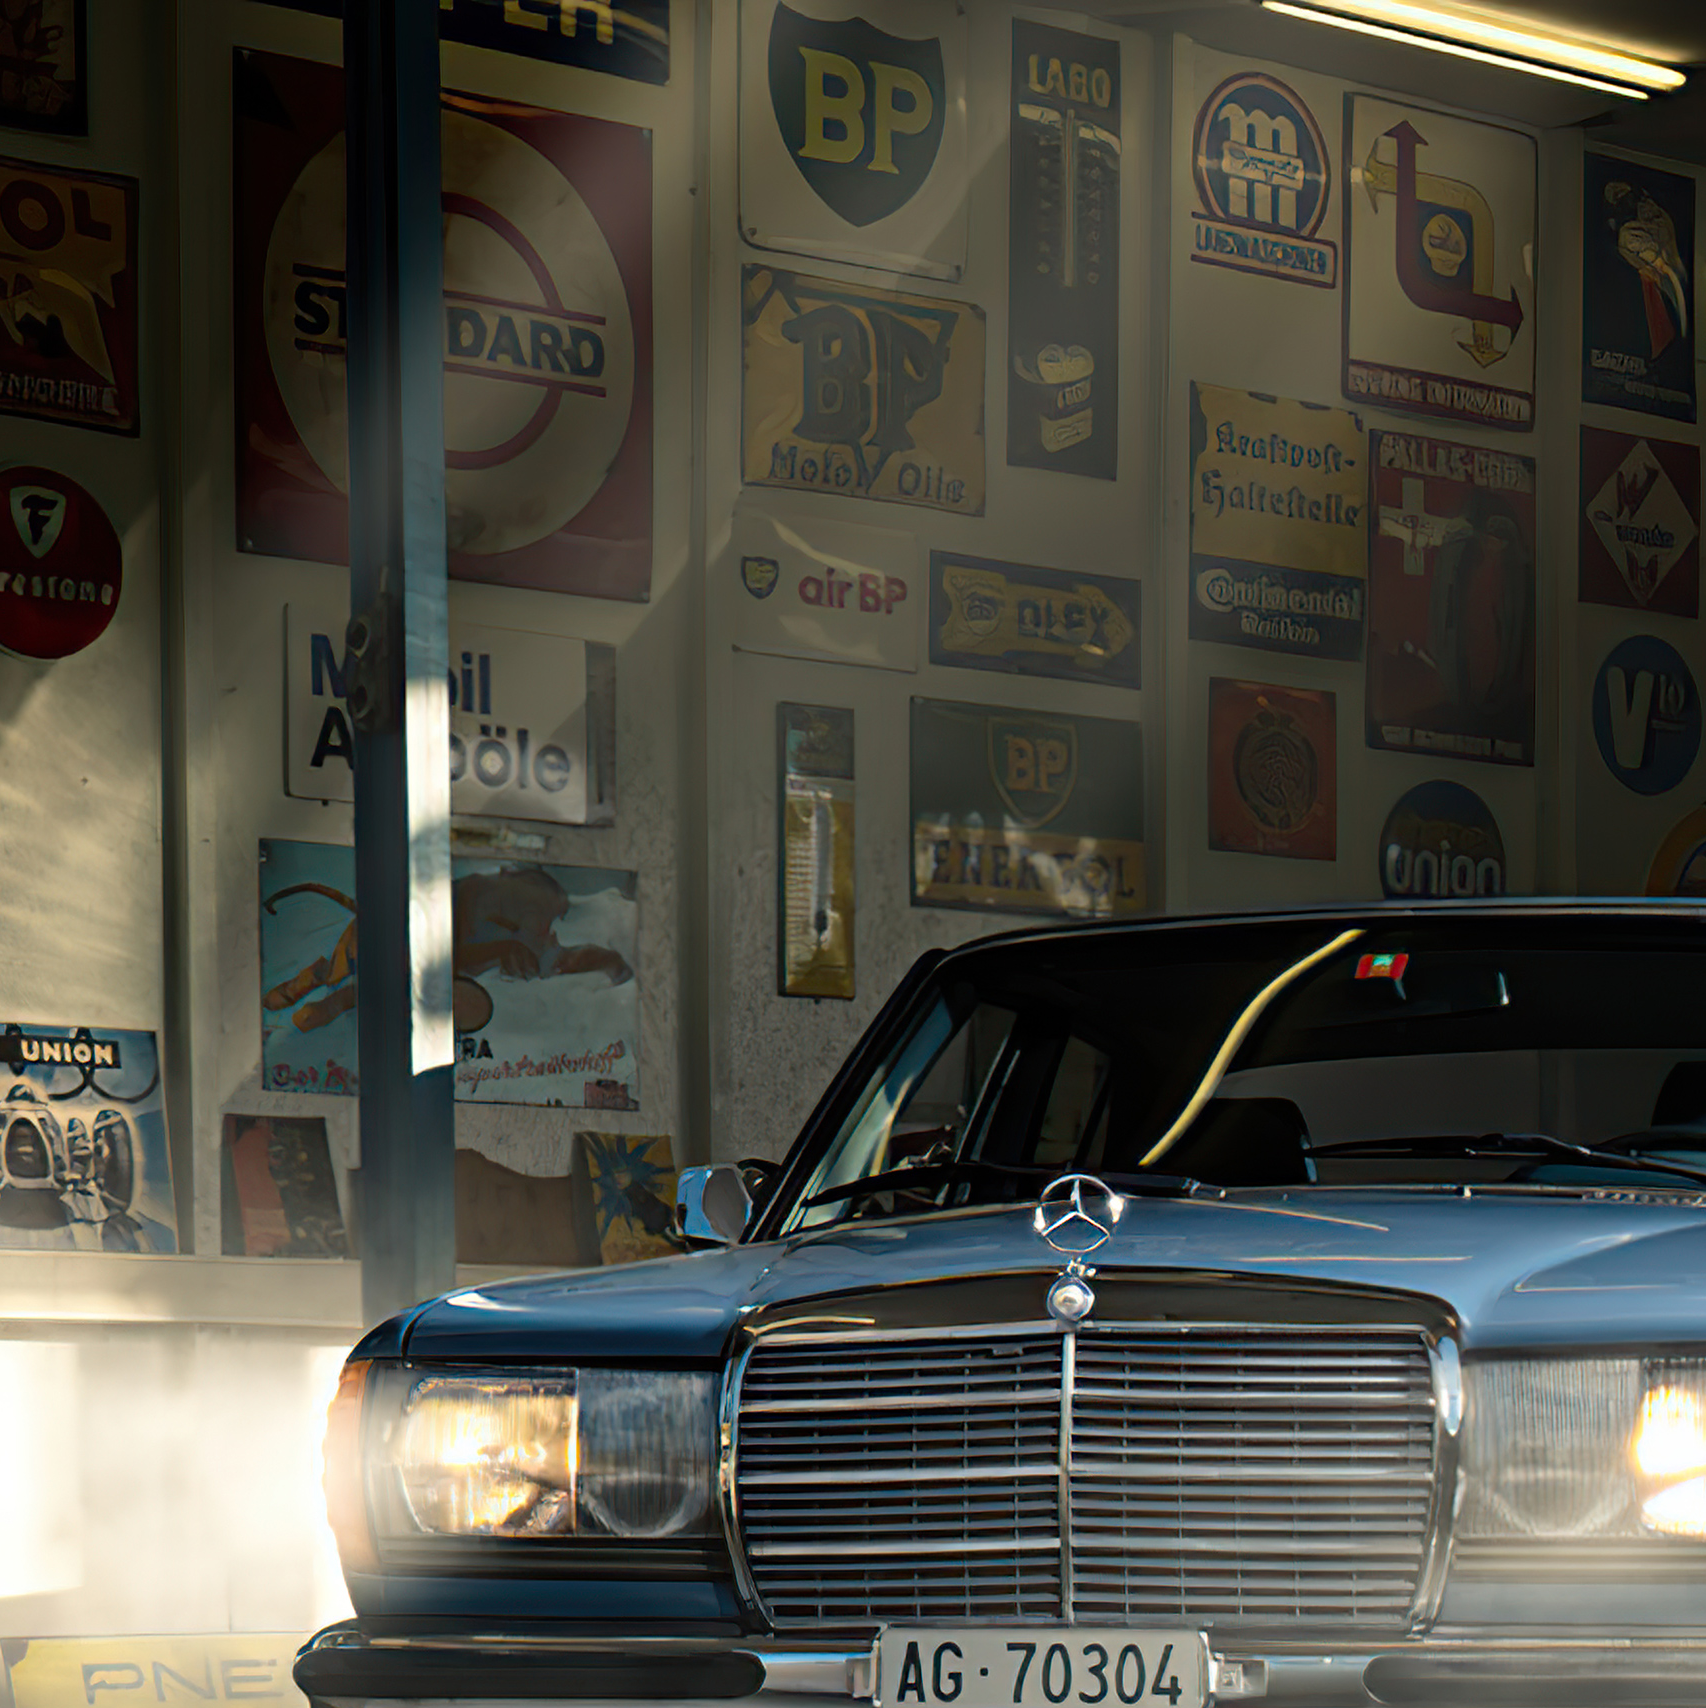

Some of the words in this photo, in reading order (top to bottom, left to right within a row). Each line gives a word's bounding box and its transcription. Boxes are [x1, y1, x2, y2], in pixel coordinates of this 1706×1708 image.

[798, 46, 933, 174] BP
[1028, 54, 1111, 108] LABO
[294, 281, 605, 378] STDARD
[781, 304, 943, 450] BP
[311, 632, 491, 714] Mil
[310, 705, 571, 793] Aöle
[1006, 734, 1071, 795] BP
[1386, 840, 1502, 896] union
[21, 1040, 113, 1066] UNION
